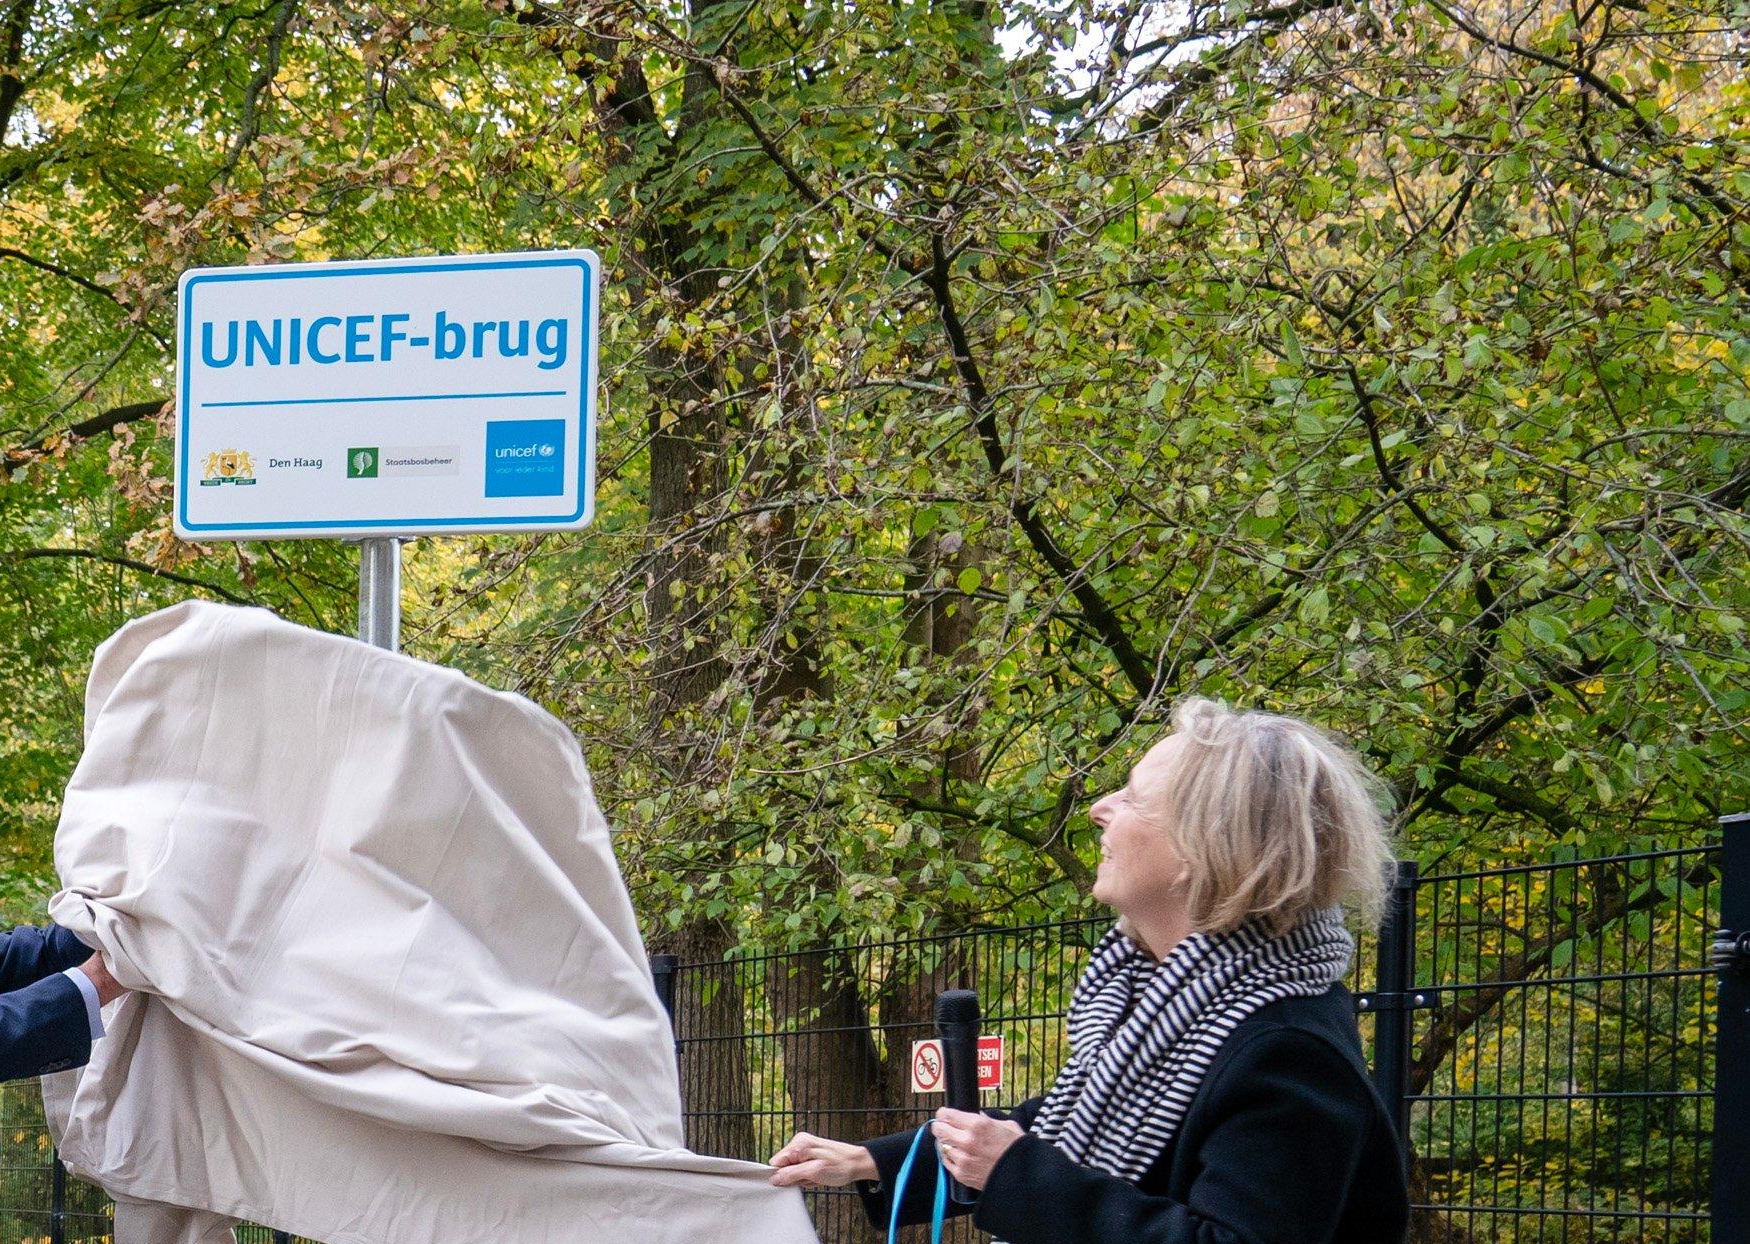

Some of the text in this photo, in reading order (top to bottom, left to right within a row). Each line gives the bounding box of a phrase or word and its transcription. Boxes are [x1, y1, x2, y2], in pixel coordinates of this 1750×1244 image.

[201, 310, 568, 370] UNICEF-brug
[495, 443, 538, 458] unicef
[269, 457, 323, 470] Den Haag
[385, 457, 453, 466] Staatsbosbeheer
[977, 1048, 999, 1061] TSEN
